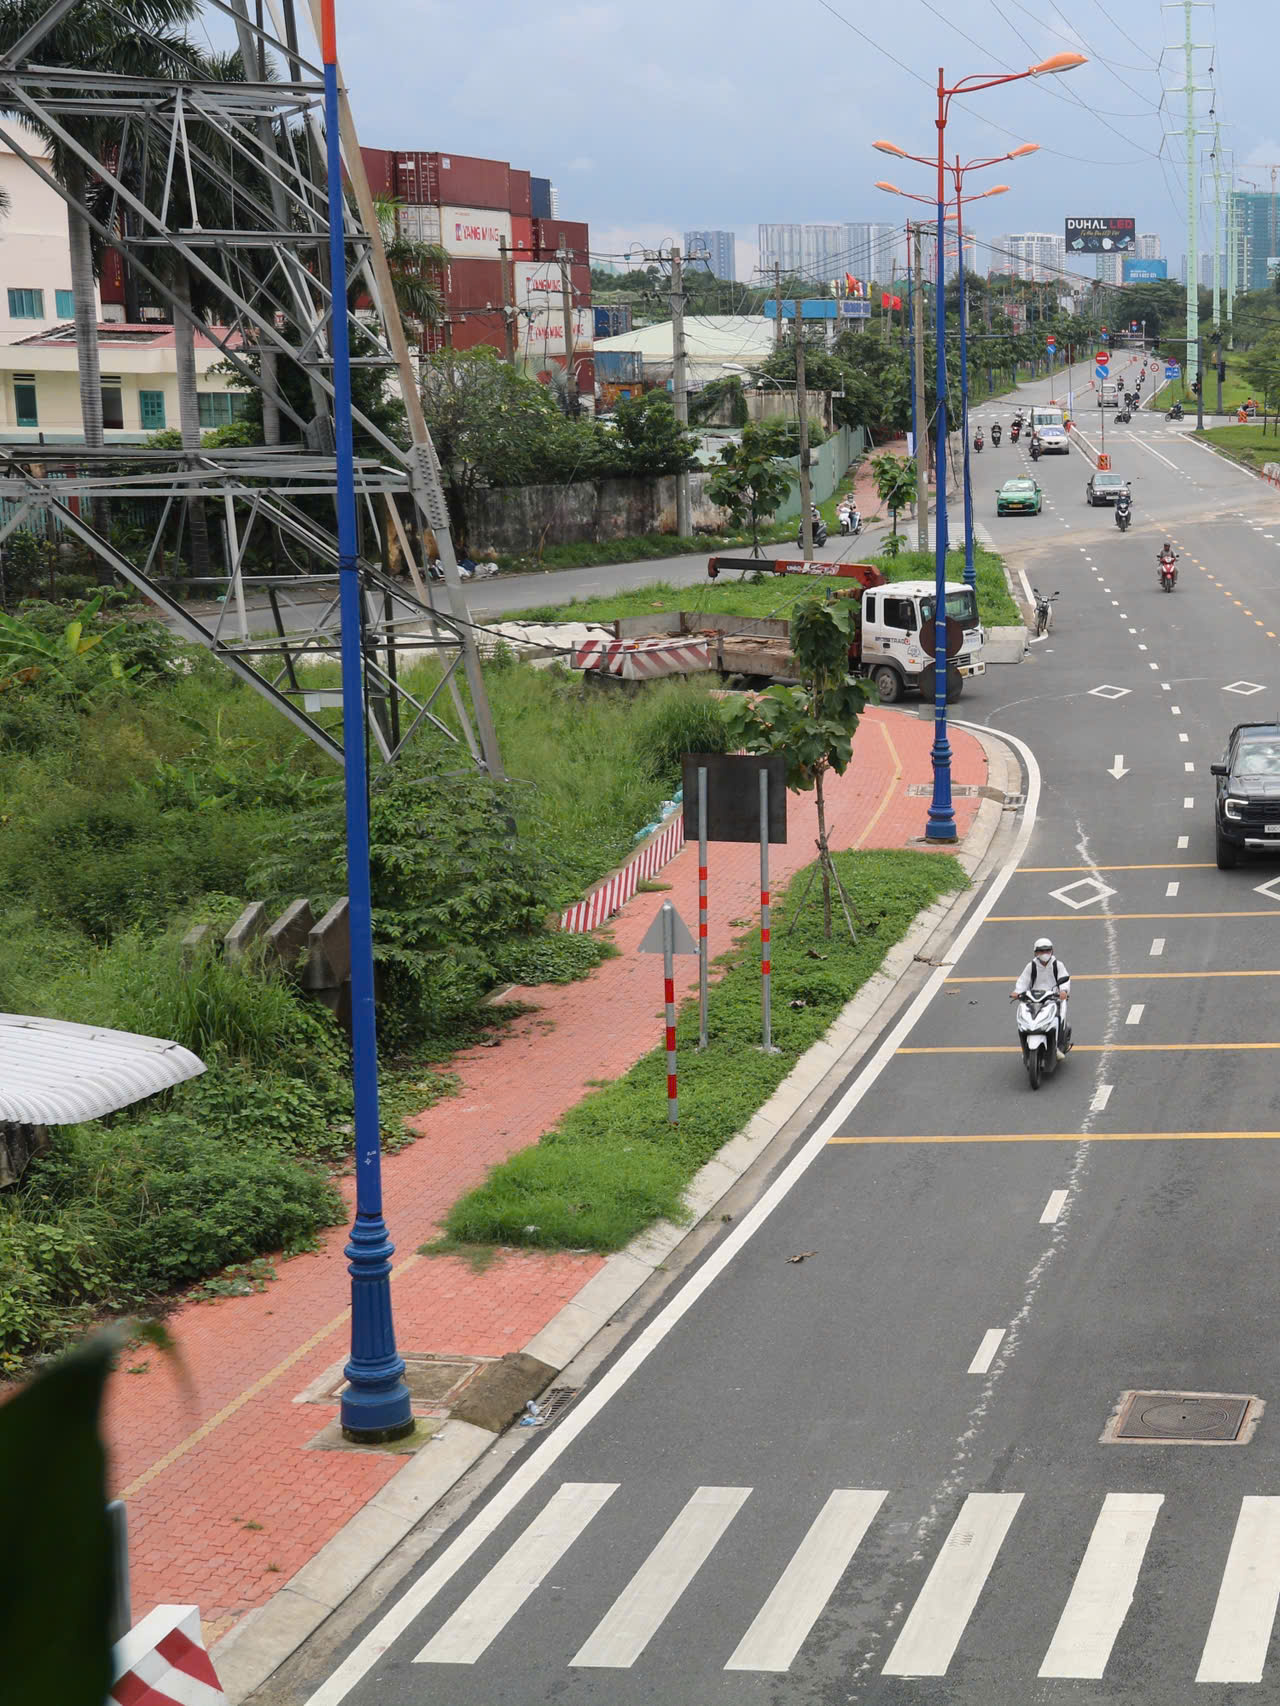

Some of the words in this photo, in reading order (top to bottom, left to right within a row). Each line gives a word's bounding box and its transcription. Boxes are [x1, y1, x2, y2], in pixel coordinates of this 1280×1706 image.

[1067, 219, 1107, 229] DUHAL
[1109, 219, 1134, 230] LED
[463, 225, 481, 241] YANG
[481, 226, 499, 242] MING
